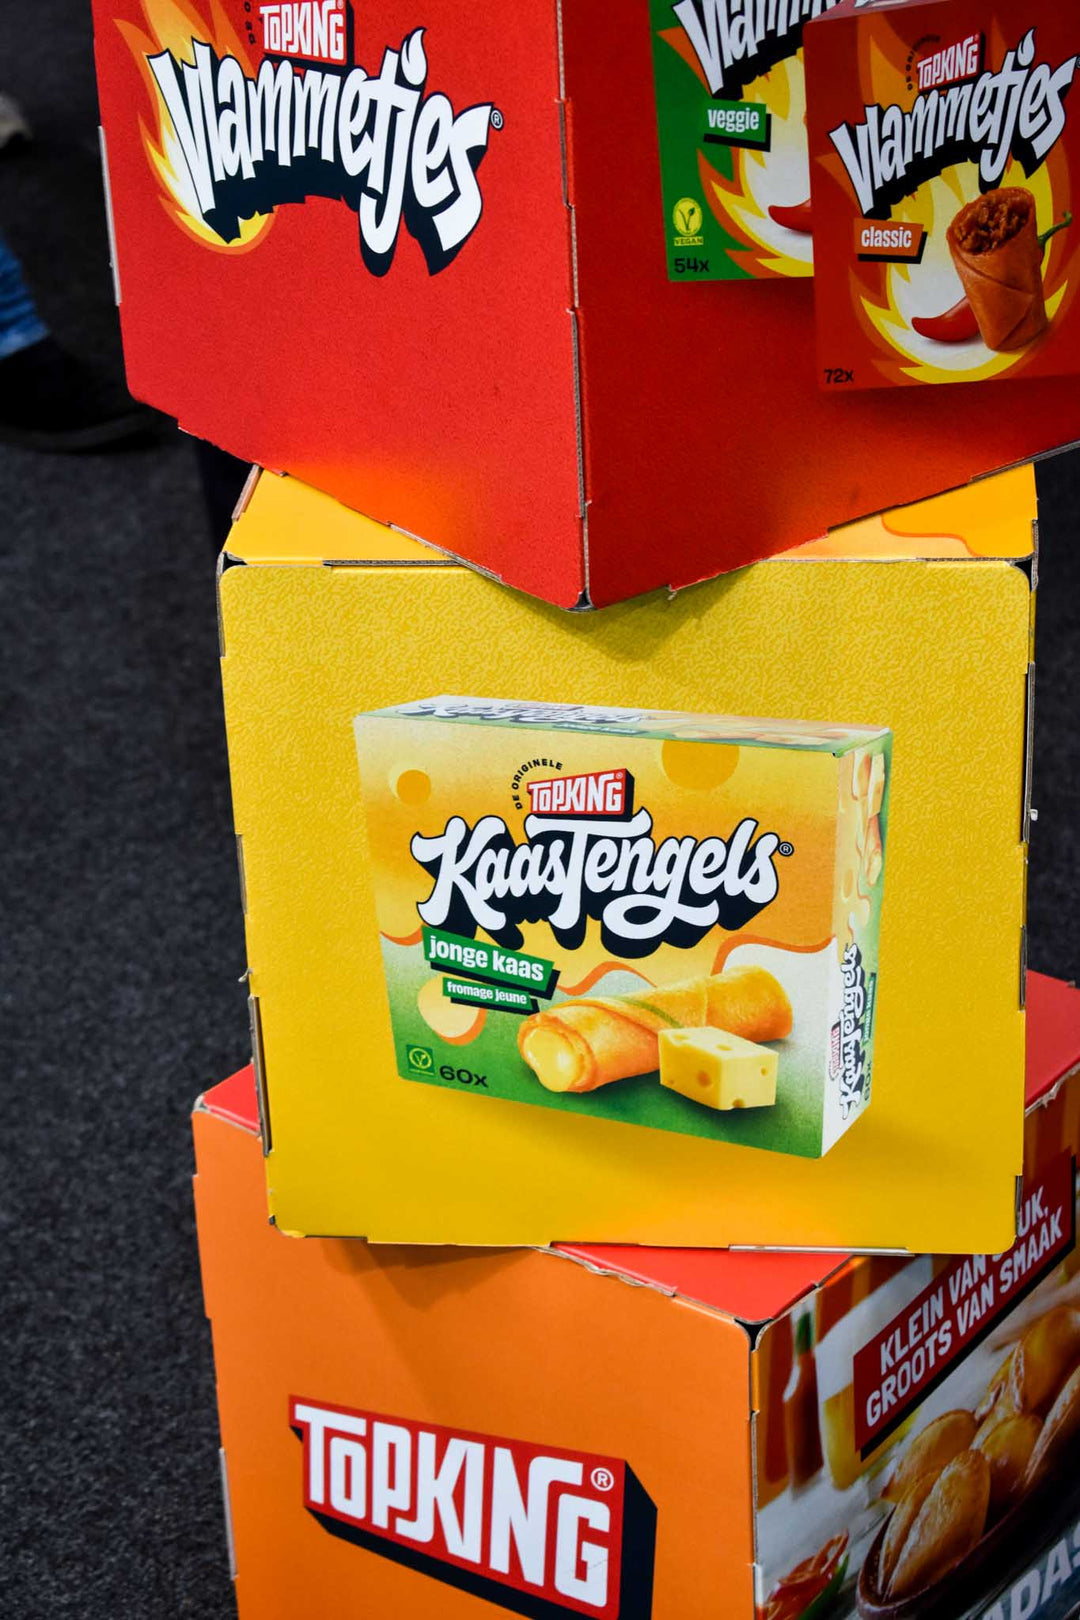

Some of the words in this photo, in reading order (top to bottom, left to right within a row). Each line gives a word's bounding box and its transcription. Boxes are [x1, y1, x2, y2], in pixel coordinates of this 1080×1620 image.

[260, 0, 344, 60] TOPKING
[917, 35, 979, 90] TOPKING
[147, 28, 492, 254] Vlammetjes
[707, 107, 760, 136] veggie
[830, 29, 1074, 215] Vlammetjes
[861, 226, 912, 248] classic
[674, 258, 710, 273] 54x
[824, 368, 854, 384] 72x
[511, 758, 563, 790] ORIGINELE
[528, 773, 623, 812] TOPKING
[512, 794, 523, 810] DE
[411, 809, 778, 940] KaasTengels
[429, 935, 488, 968] jonge
[492, 950, 544, 981] kaas
[447, 981, 493, 999] fromage
[494, 989, 527, 1004] jeune
[440, 1065, 489, 1088] 60x
[866, 1319, 952, 1427] GROOTS
[956, 1274, 994, 1337] VAN
[1000, 1205, 1063, 1294] SMAAK
[880, 1285, 943, 1376] KLEIN
[949, 1253, 986, 1306] VAN
[294, 1404, 611, 1608] TOPKING
